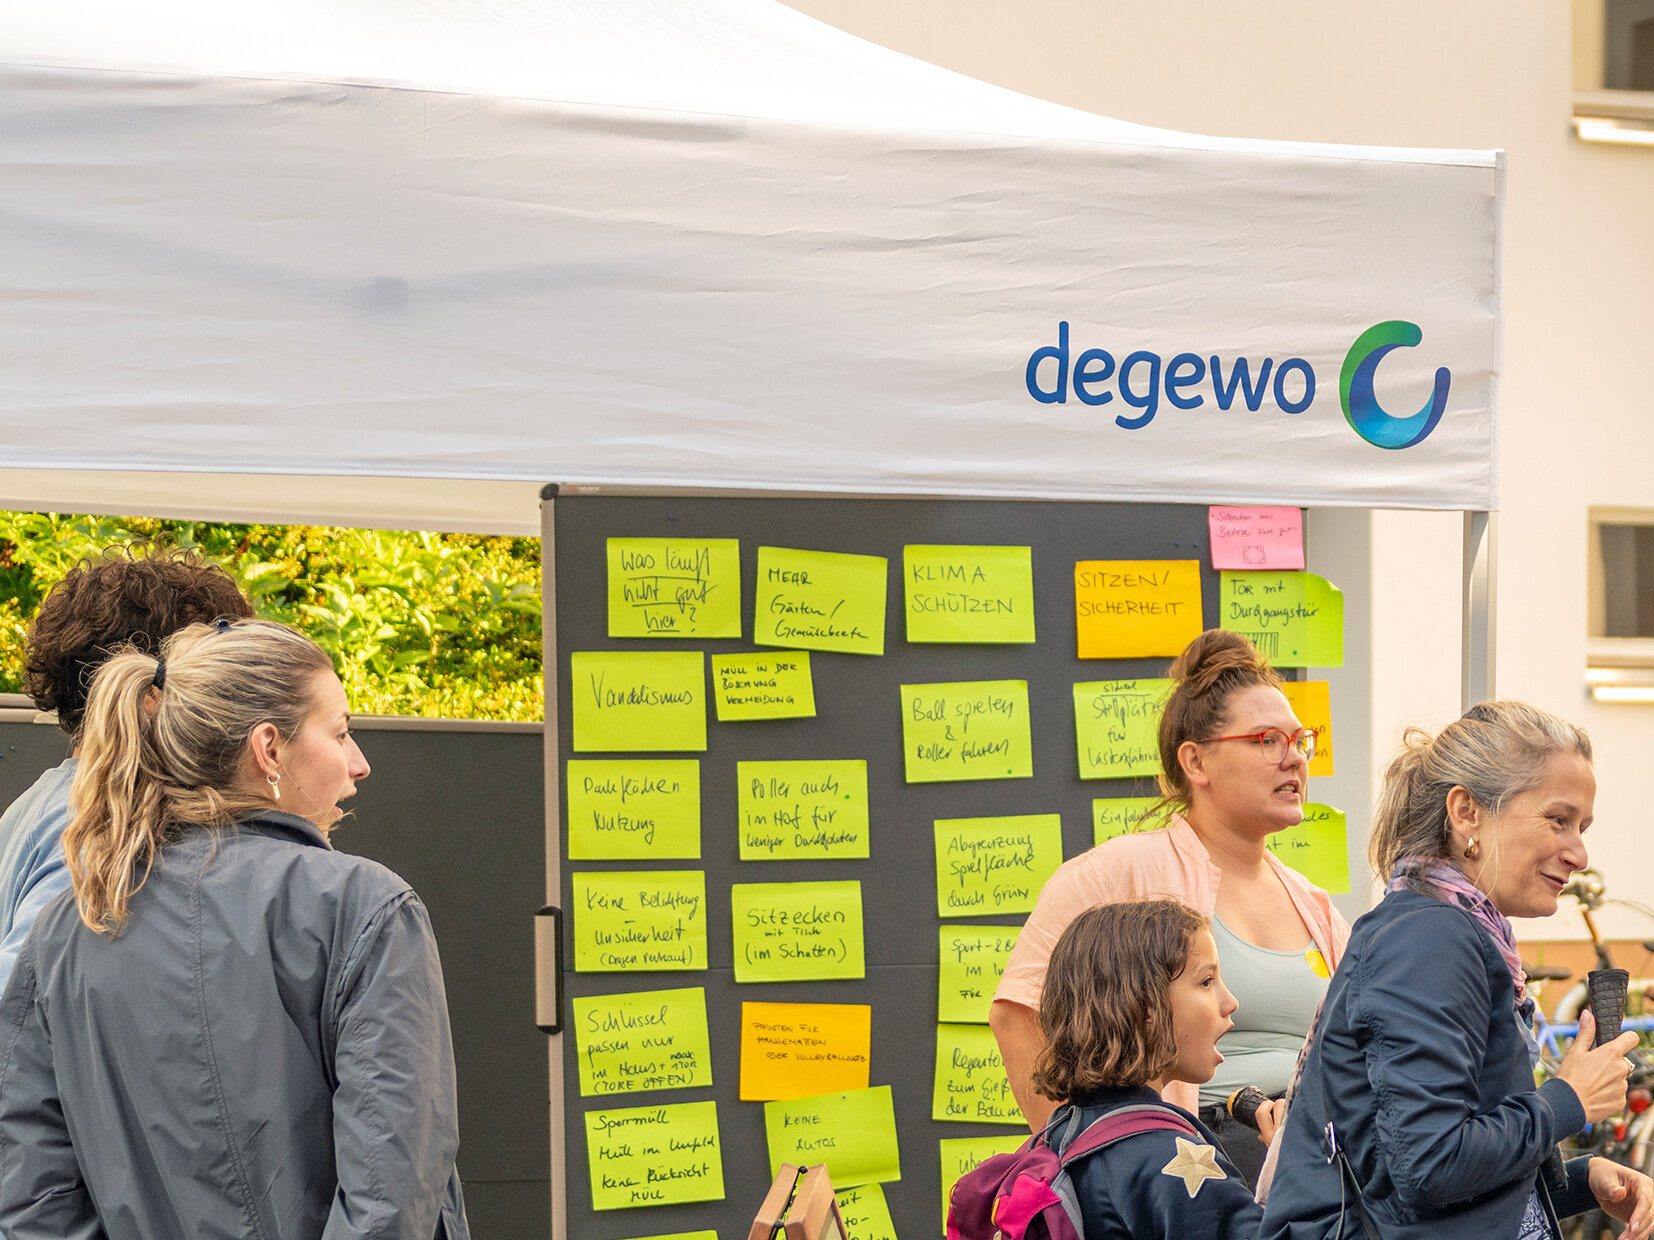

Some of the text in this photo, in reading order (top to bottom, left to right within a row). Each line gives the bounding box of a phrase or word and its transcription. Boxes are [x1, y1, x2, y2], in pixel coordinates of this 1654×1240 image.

[1025, 320, 1316, 430] degewo
[666, 547, 710, 580] läuft
[913, 565, 987, 583] KLIMA
[768, 569, 813, 585] MEHR
[912, 593, 1013, 613] SCHÜTZEN
[1078, 601, 1184, 616] SICHERHEIT
[590, 670, 693, 708] Vandalismus
[913, 695, 1013, 732] Ball spielen
[961, 739, 1009, 763] fahren
[801, 774, 839, 796] auch
[593, 810, 655, 845] Nutzung
[812, 806, 837, 830] für
[747, 906, 845, 927] Sitzecken
[587, 1002, 668, 1033] Schlüssel
[588, 1036, 674, 1069] passen nur
[593, 1110, 670, 1138] Sperrmüll
[784, 1112, 821, 1127] KEINE
[795, 1137, 836, 1151] AUTOS
